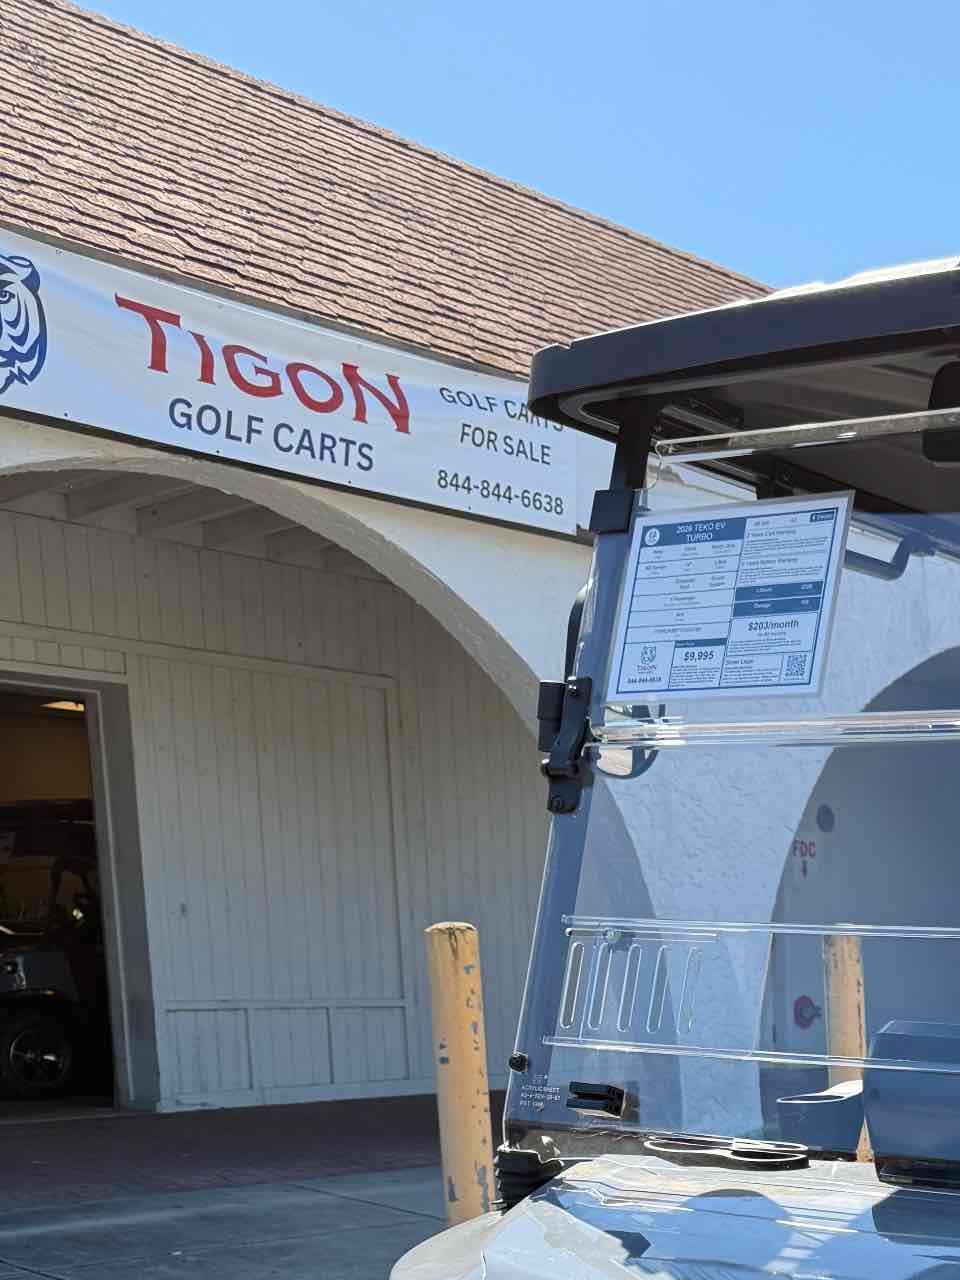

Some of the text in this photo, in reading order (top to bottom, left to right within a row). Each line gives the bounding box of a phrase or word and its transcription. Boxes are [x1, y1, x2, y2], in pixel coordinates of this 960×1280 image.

[114, 292, 411, 434] TIGON
[439, 387, 499, 413] GOLF
[168, 398, 374, 472] GOLF CARTS
[460, 423, 551, 465] FOR SALE
[437, 469, 564, 515] 844-844-6638
[683, 650, 715, 662] $9,995
[792, 839, 817, 858] FDC
